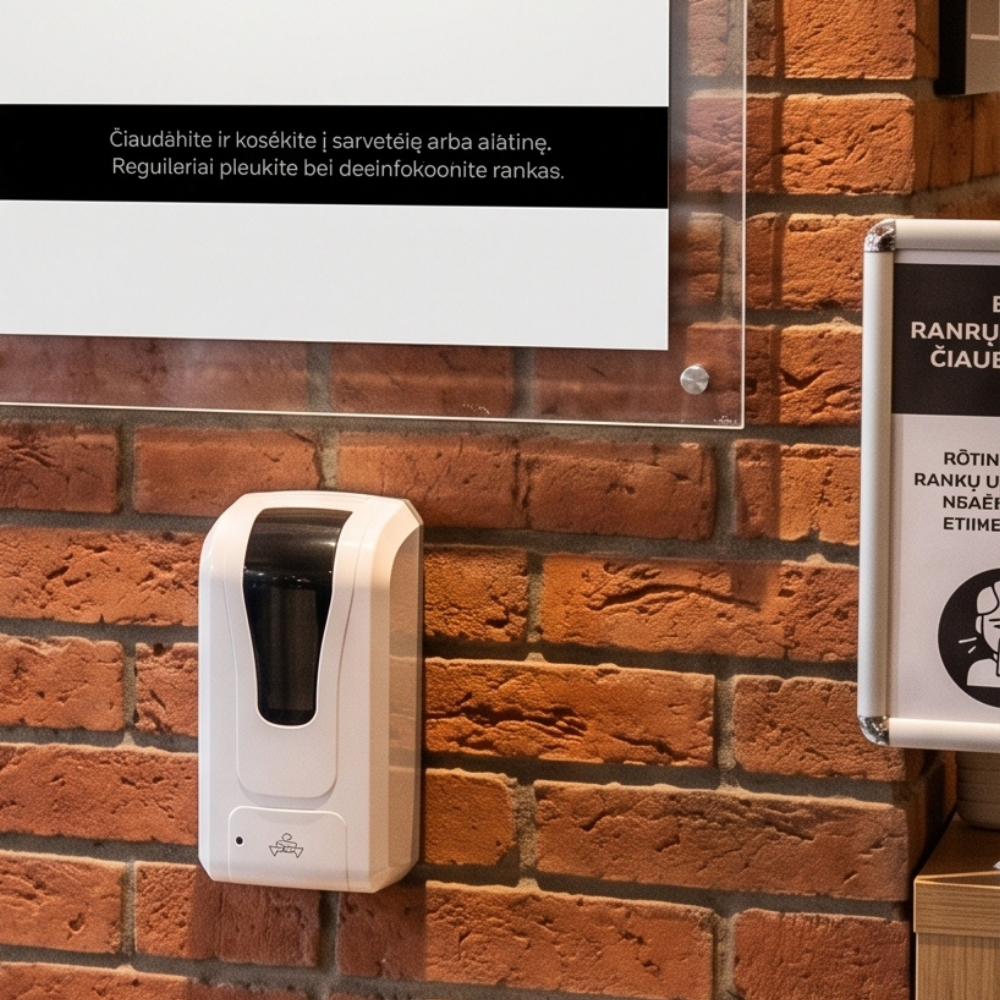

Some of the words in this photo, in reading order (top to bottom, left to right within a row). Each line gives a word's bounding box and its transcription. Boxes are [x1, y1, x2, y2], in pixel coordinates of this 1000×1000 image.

[218, 130, 231, 148] ir
[427, 132, 473, 150] arba
[220, 158, 298, 180] pleukite
[304, 158, 333, 177] bei
[493, 161, 564, 180] rankas.
